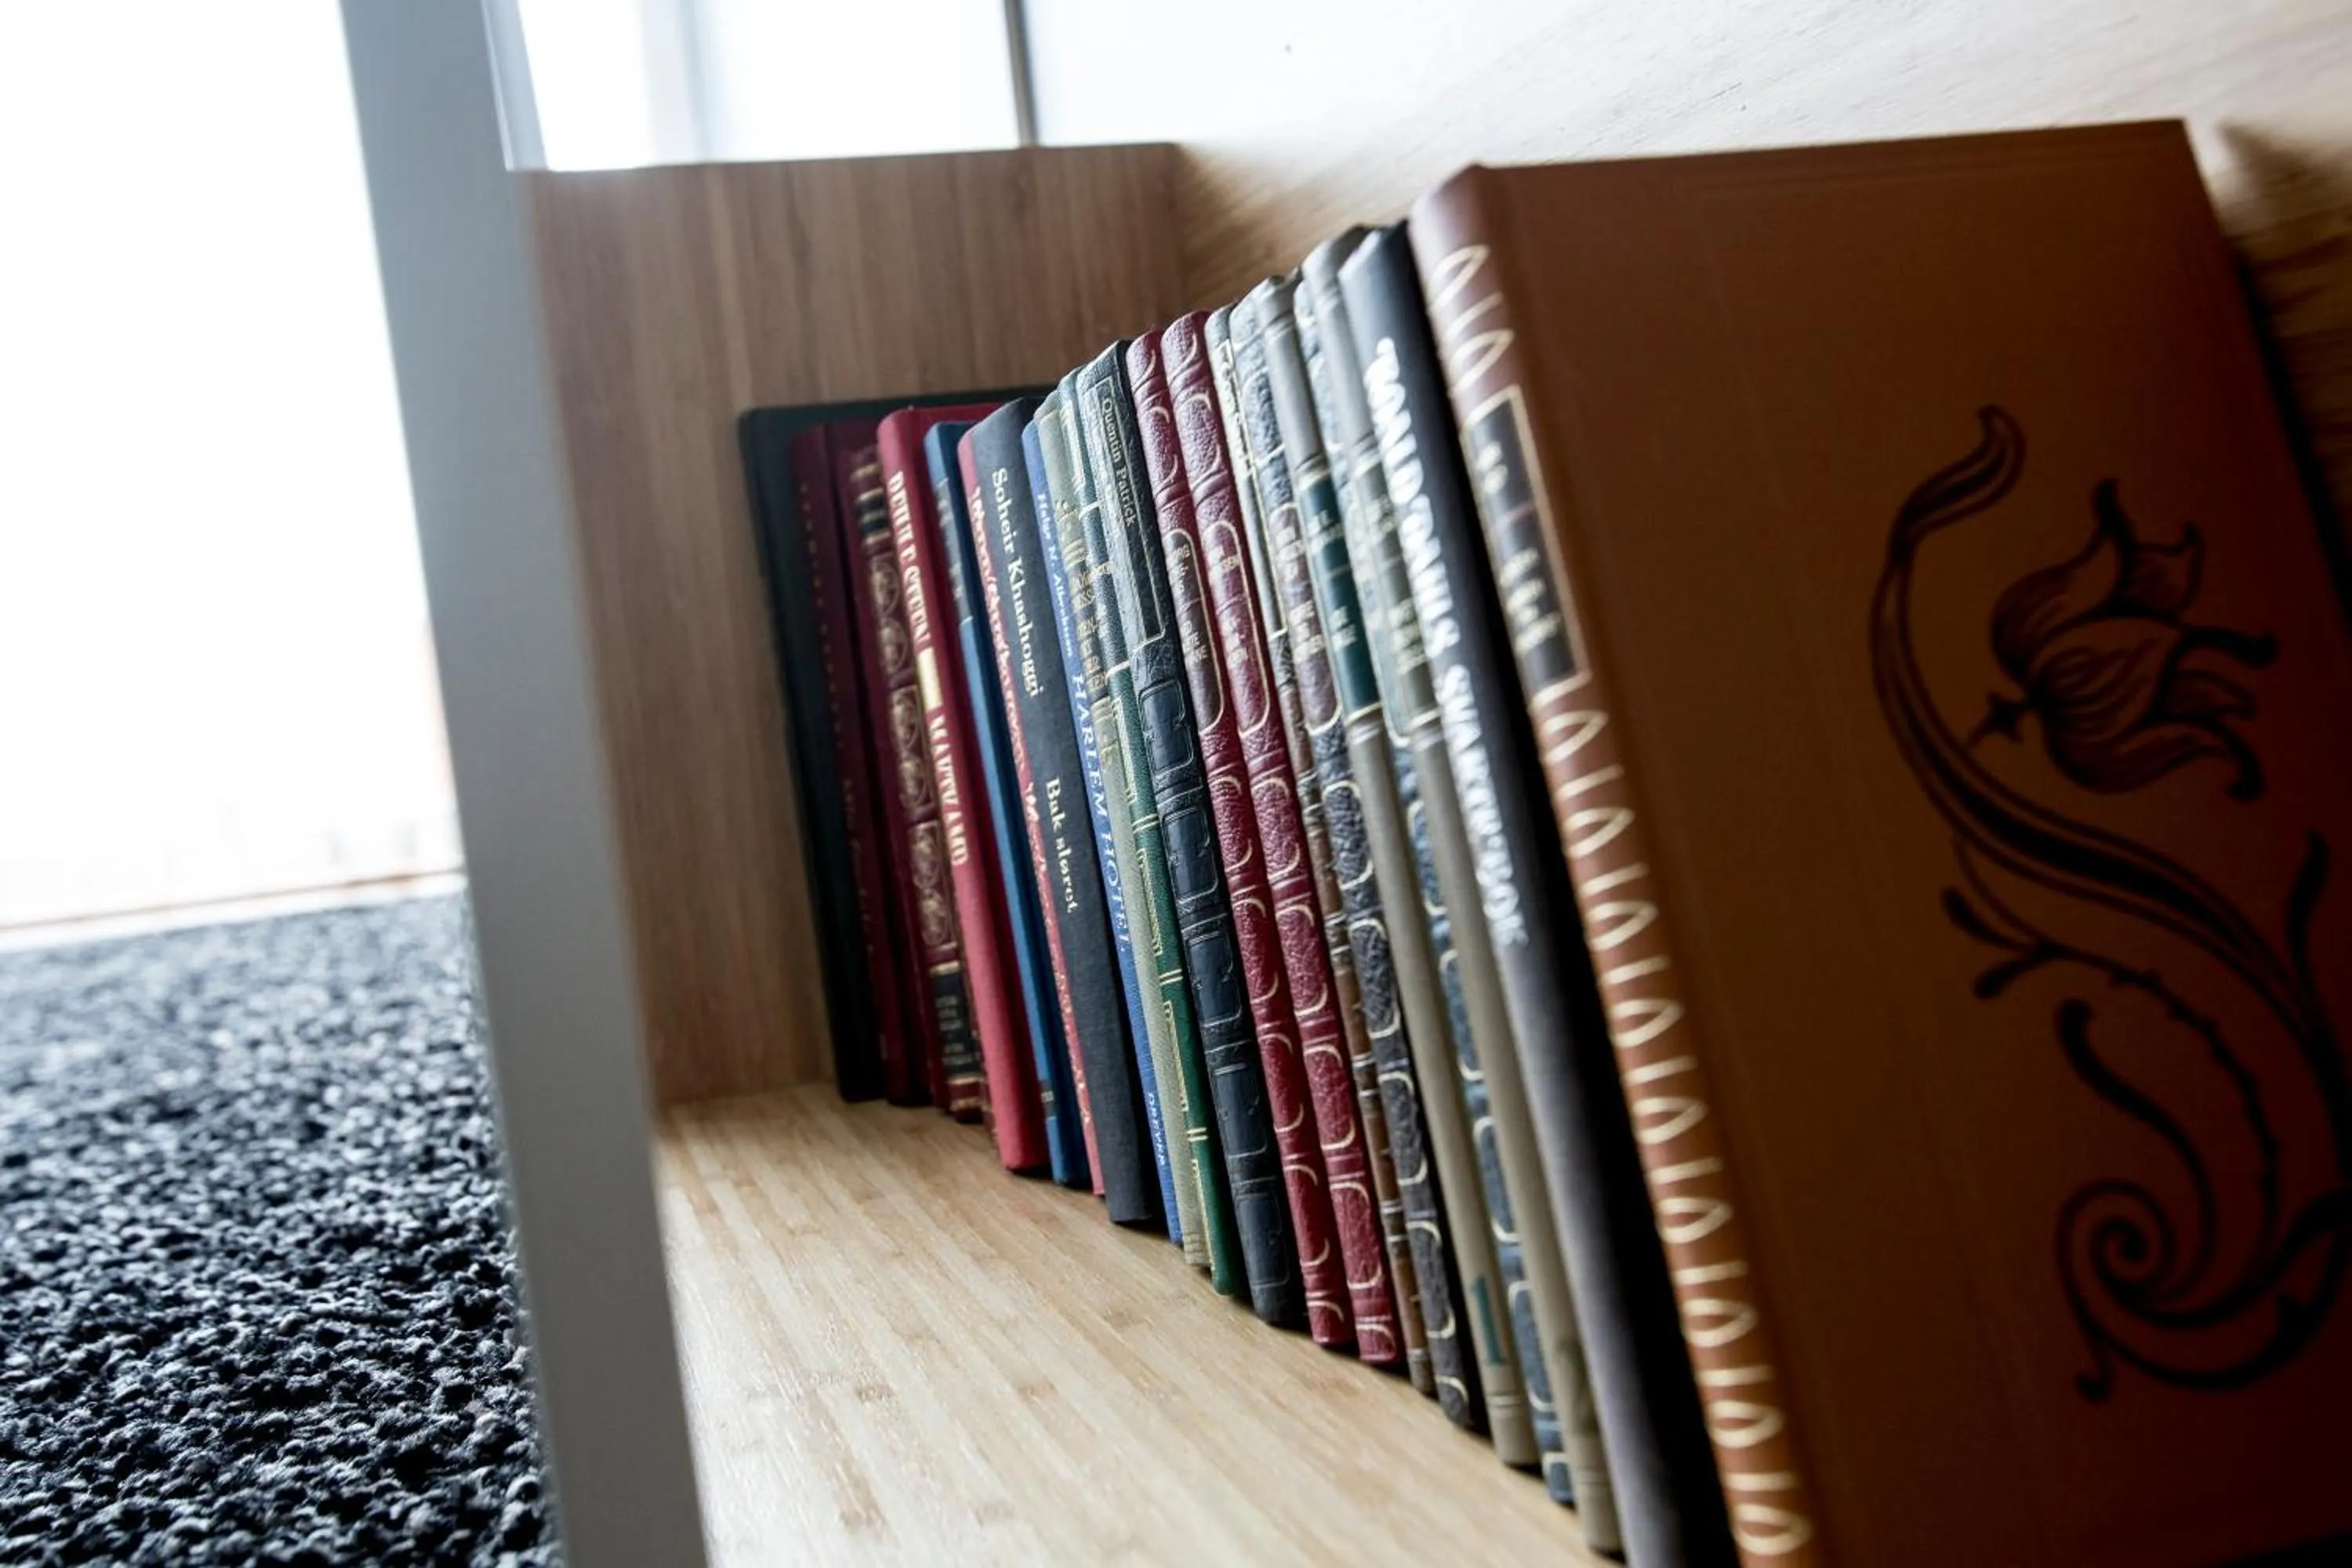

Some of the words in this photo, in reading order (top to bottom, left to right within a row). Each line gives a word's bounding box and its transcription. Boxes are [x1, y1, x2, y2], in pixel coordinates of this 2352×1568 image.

[1102, 397, 1122, 464] Quentin
[1116, 465, 1137, 528] Patrick
[992, 467, 1017, 554] Soheir
[1007, 556, 1044, 698] Khashoggi
[1046, 778, 1066, 834] Bak
[1056, 837, 1079, 914] sløret
[1072, 674, 1108, 817] HARLEM
[1101, 832, 1131, 942] HOTEL
